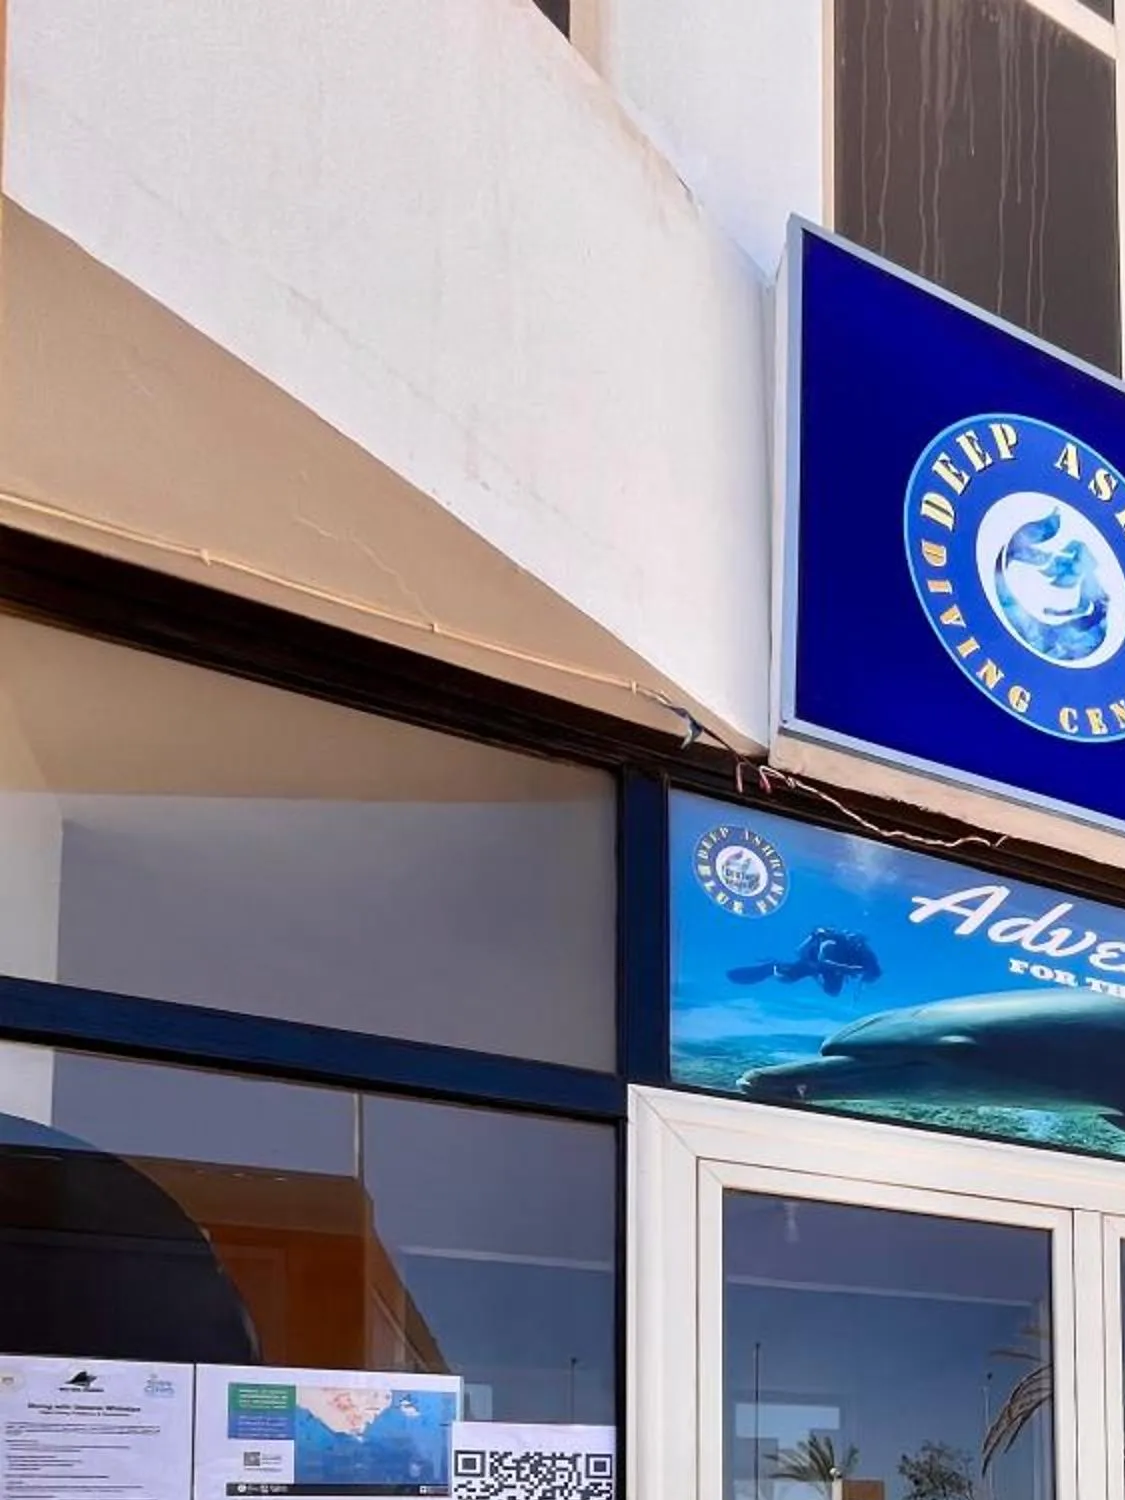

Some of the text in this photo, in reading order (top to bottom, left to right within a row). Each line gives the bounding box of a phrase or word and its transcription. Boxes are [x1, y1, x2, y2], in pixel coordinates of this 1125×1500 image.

[919, 421, 1018, 531] DEEP
[920, 541, 1032, 713] DIVING
[1008, 958, 1079, 990] FOR
